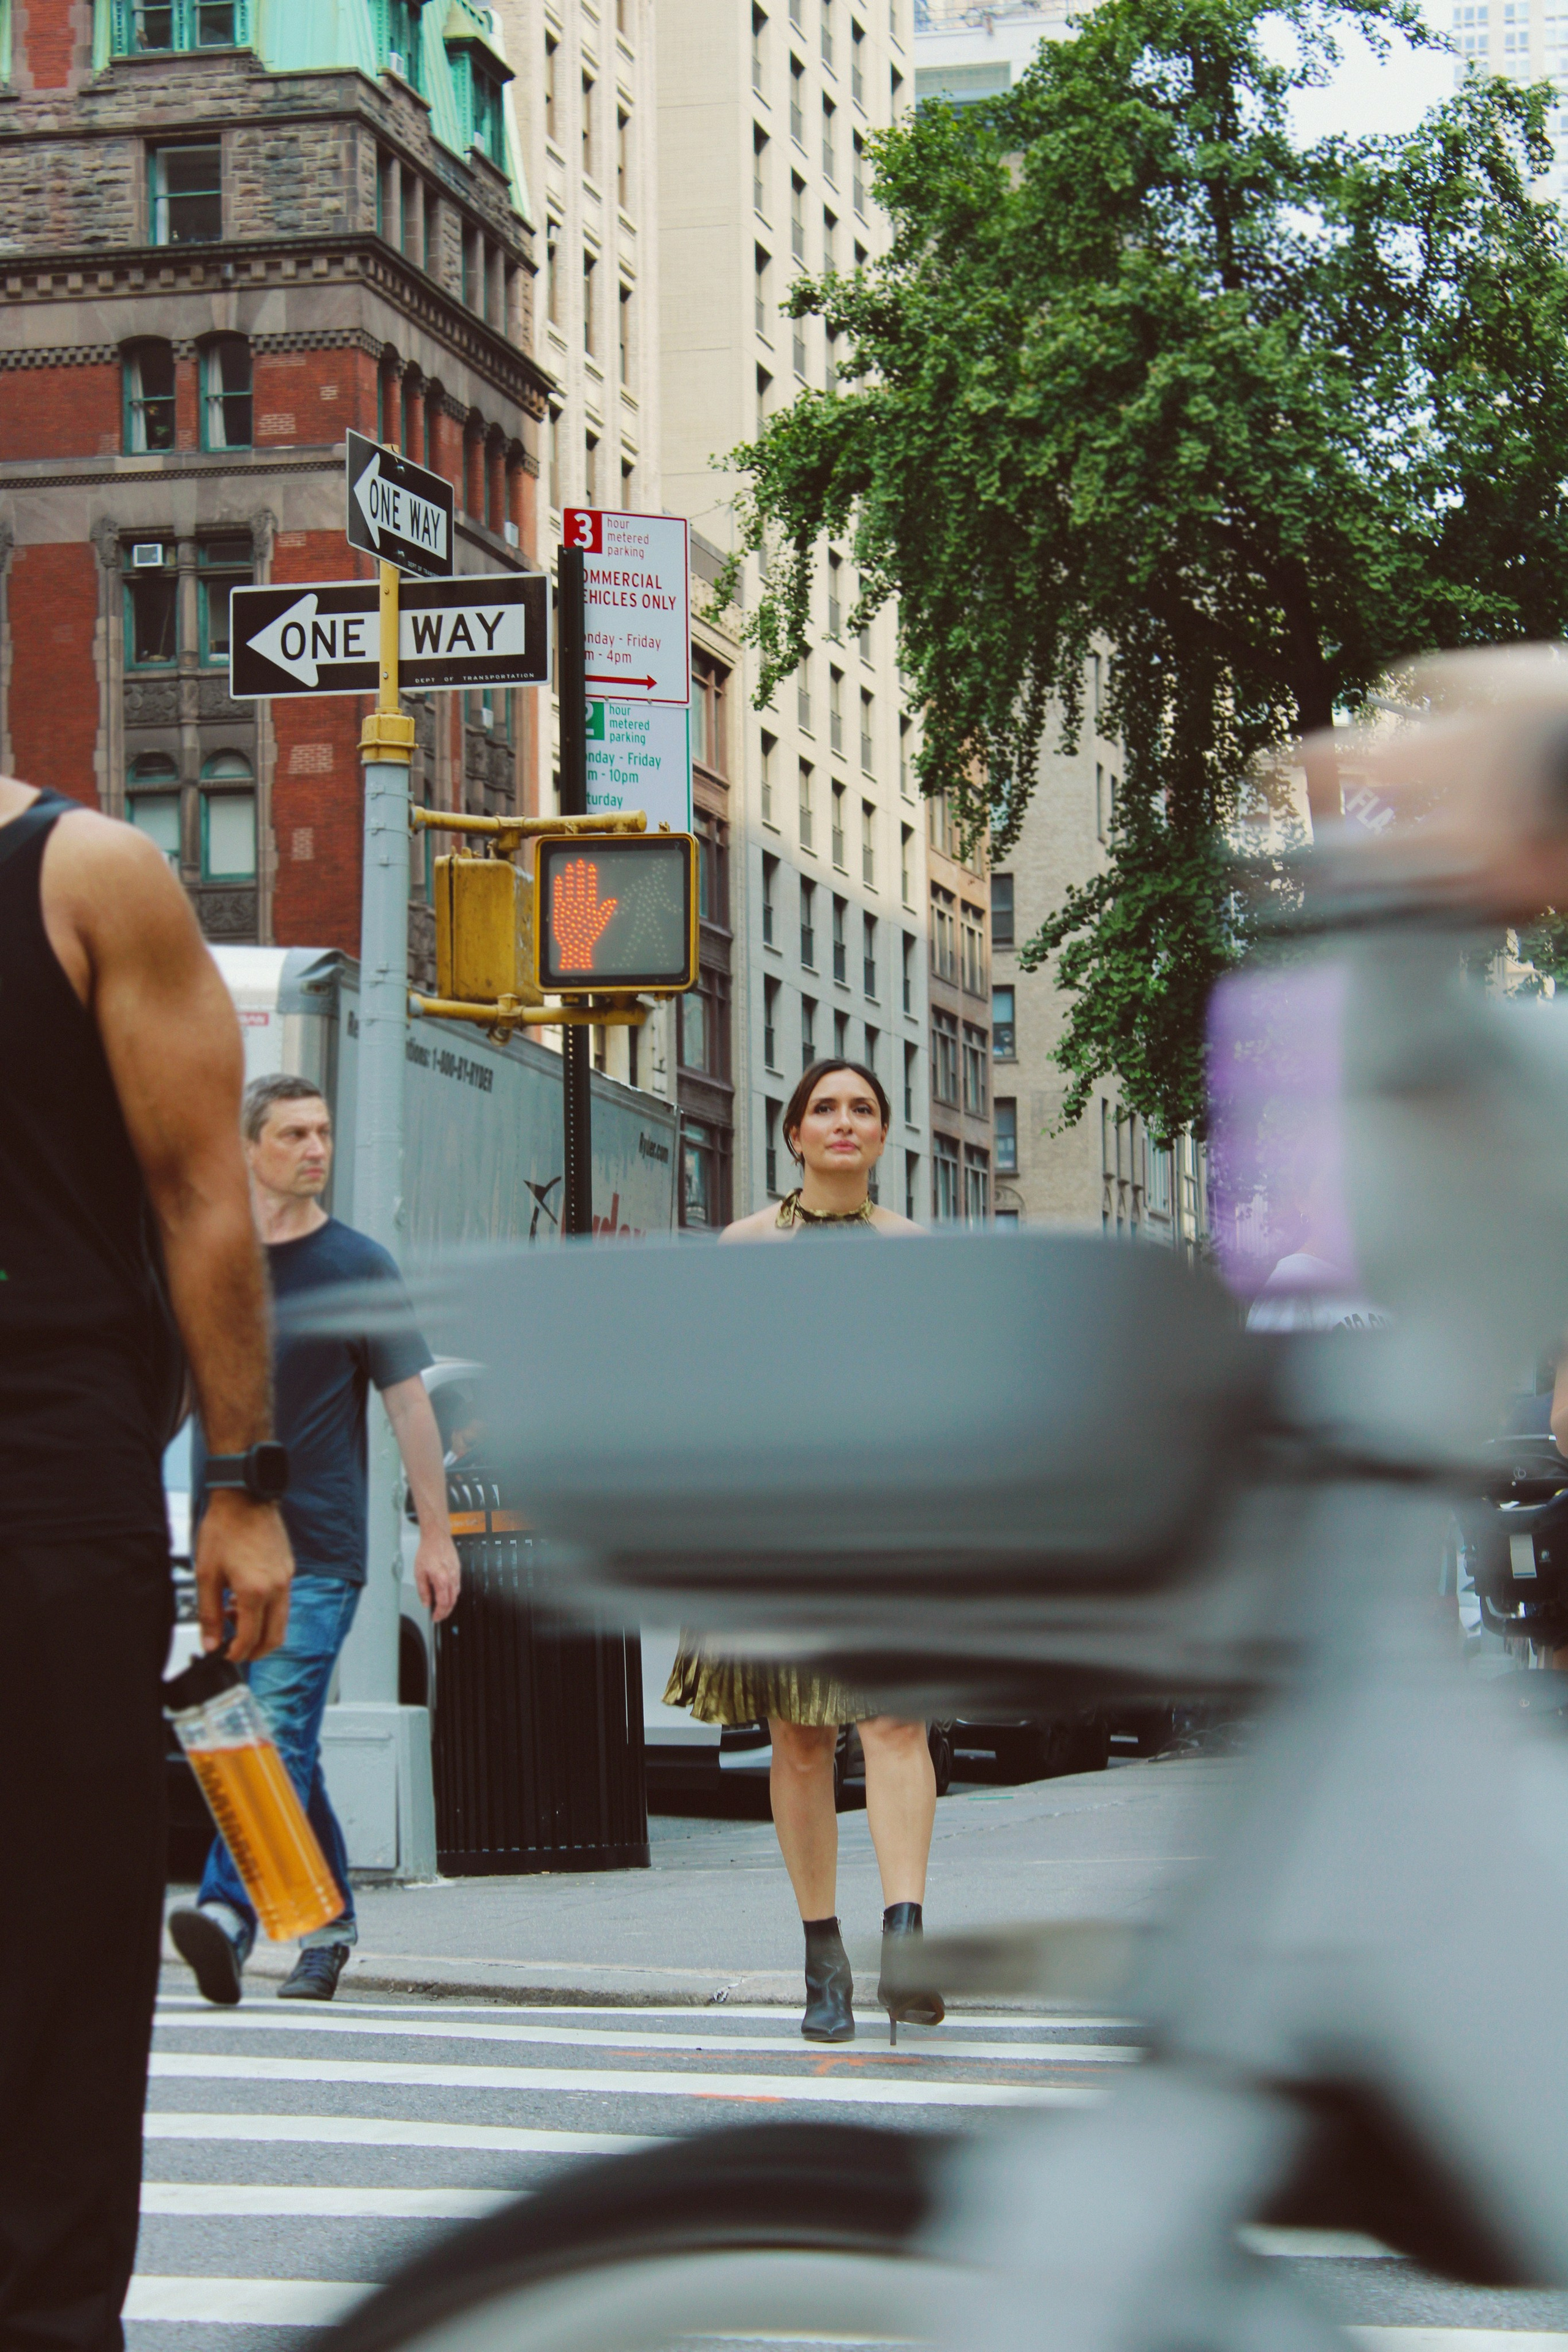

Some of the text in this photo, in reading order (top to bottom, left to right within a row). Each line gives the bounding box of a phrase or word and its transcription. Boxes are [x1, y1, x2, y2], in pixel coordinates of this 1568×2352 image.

[370, 478, 440, 549] ONE WAY
[573, 513, 594, 549] 3
[607, 518, 630, 529] hour
[607, 532, 649, 545] metered
[607, 546, 644, 560] parking
[584, 568, 662, 589] OMMERCIAL
[584, 589, 676, 611] EHICLES ONLY
[281, 611, 505, 661] ONE WAY
[585, 631, 615, 647] nday
[627, 633, 662, 652] Friday
[606, 650, 632, 665] 4pm
[609, 704, 631, 716] hour
[609, 718, 650, 731] metered
[609, 732, 646, 745] parking
[586, 750, 615, 765] nday
[628, 752, 662, 770] Friday
[609, 769, 639, 785] 10pm
[587, 791, 624, 809] turday
